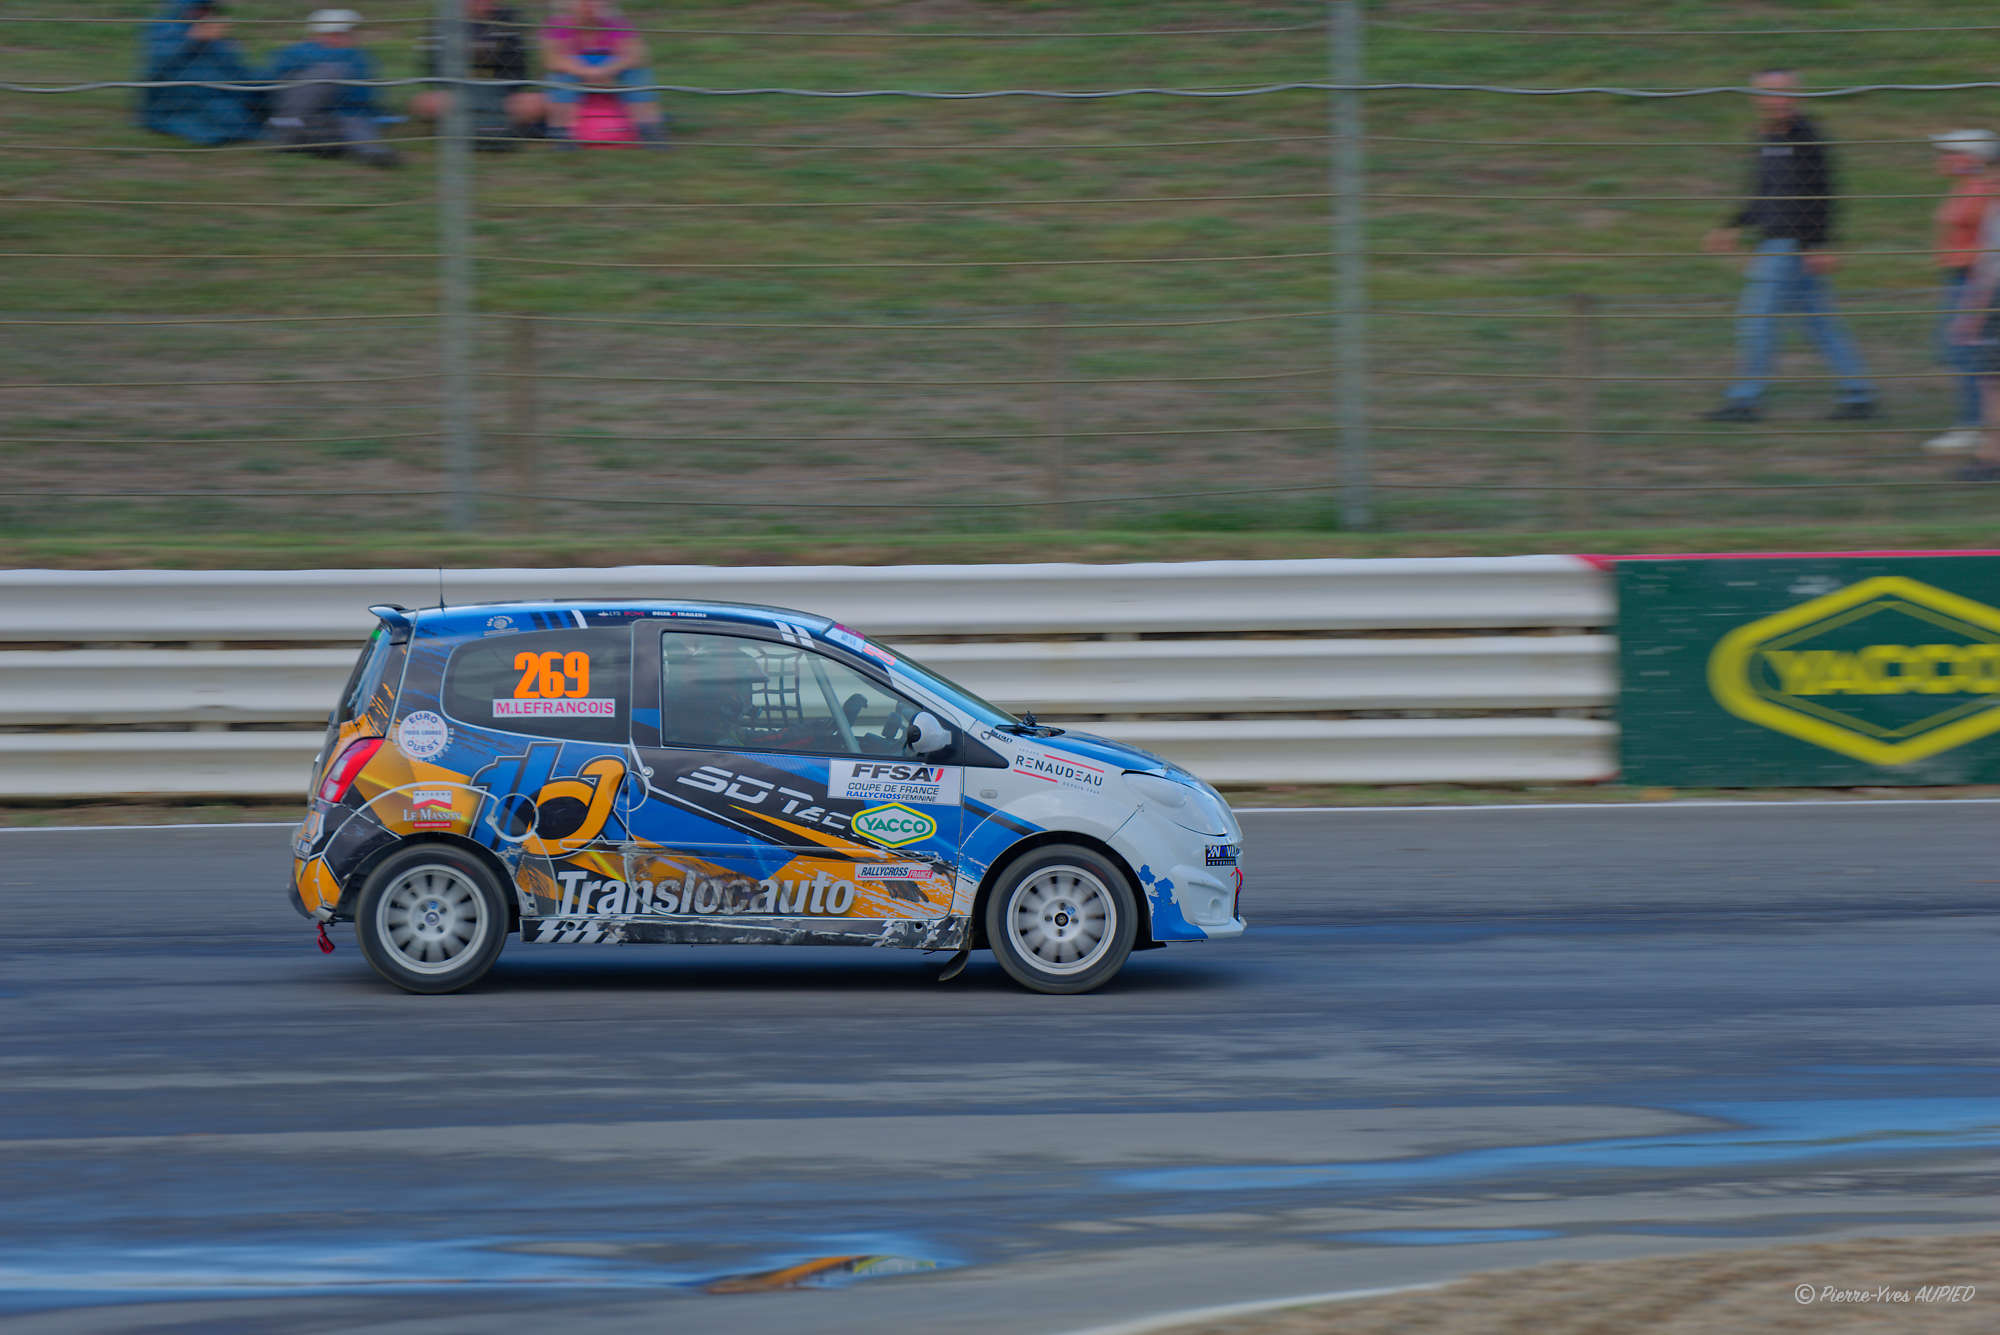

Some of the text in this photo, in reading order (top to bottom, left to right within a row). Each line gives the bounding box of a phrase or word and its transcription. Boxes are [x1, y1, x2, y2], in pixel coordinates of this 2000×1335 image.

[513, 651, 590, 699] 269
[495, 702, 614, 714] M.LEFRANCOIS
[408, 712, 438, 724] EURO
[407, 740, 439, 752] OUEST
[852, 763, 932, 782] FFSA
[1015, 755, 1103, 786] RENAUDEAU
[848, 782, 940, 795] COUPE DE FRANCE
[864, 817, 926, 833] YACCO
[861, 866, 908, 876] RALLYCROSS
[557, 870, 856, 915] Translocauto
